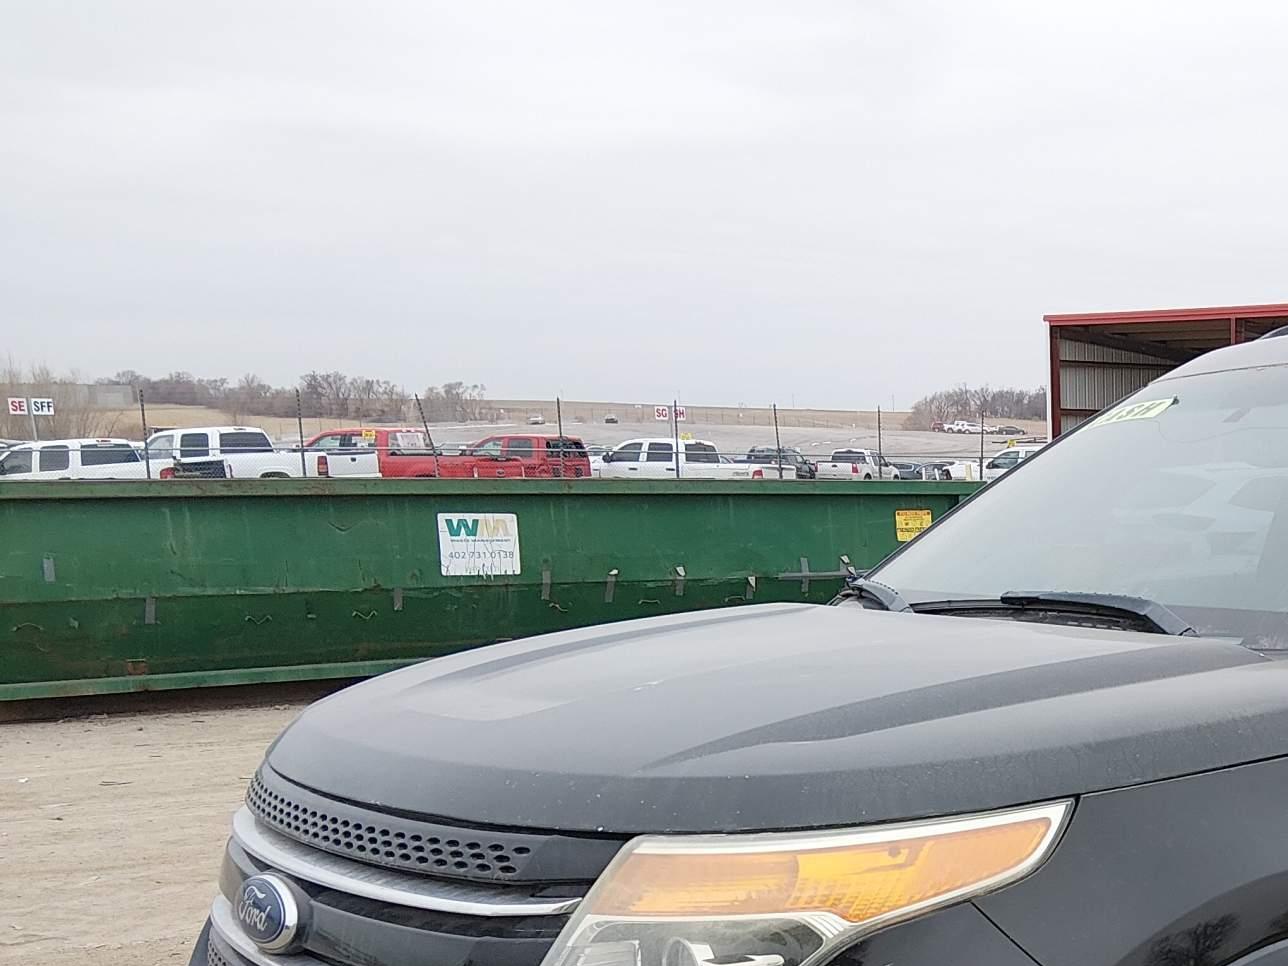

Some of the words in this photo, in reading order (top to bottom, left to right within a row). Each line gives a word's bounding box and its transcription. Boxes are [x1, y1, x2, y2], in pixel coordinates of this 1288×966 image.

[10, 400, 26, 412] SE
[33, 400, 53, 412] SFF
[656, 408, 668, 418] SG
[448, 551, 466, 559] 402
[469, 551, 487, 559] 731
[238, 885, 272, 932] Ford
